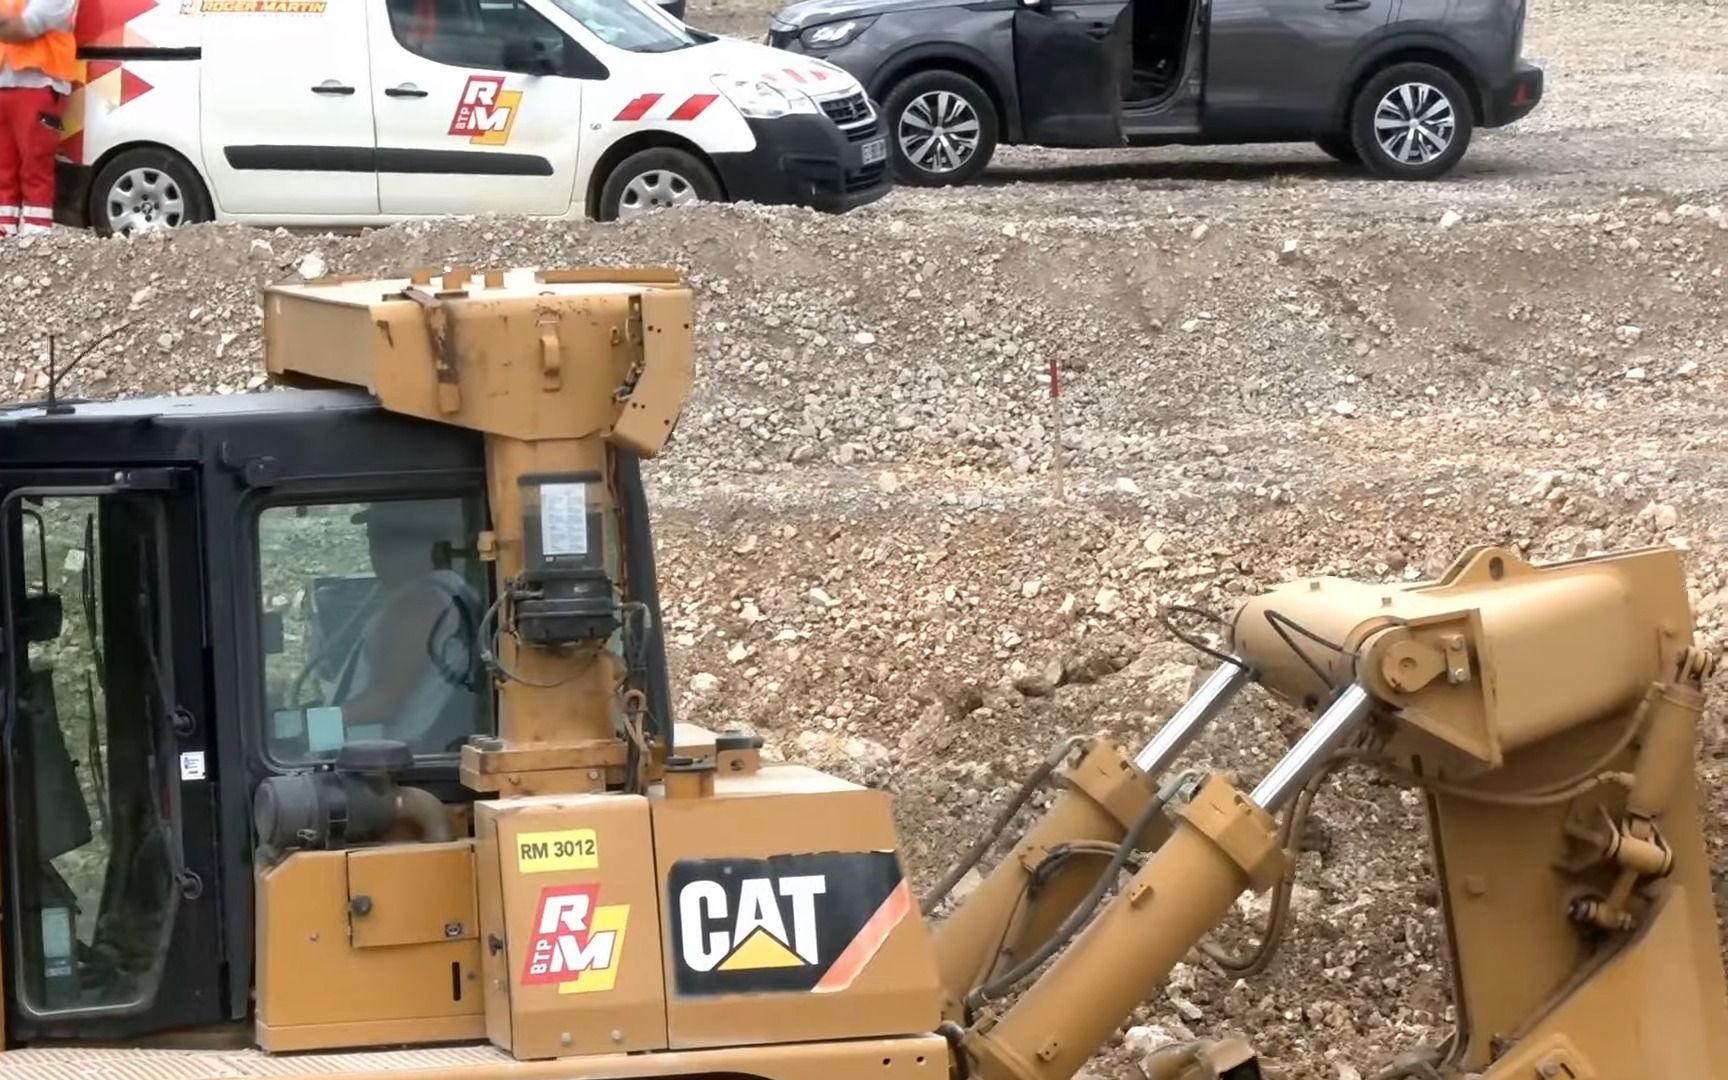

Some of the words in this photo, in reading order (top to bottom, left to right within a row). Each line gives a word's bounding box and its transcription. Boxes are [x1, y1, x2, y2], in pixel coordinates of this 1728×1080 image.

[261, 1, 326, 13] MARTIN
[520, 842, 549, 860] RM
[553, 839, 596, 858] 3012
[679, 874, 827, 972] CAT
[529, 938, 552, 975] BTP
